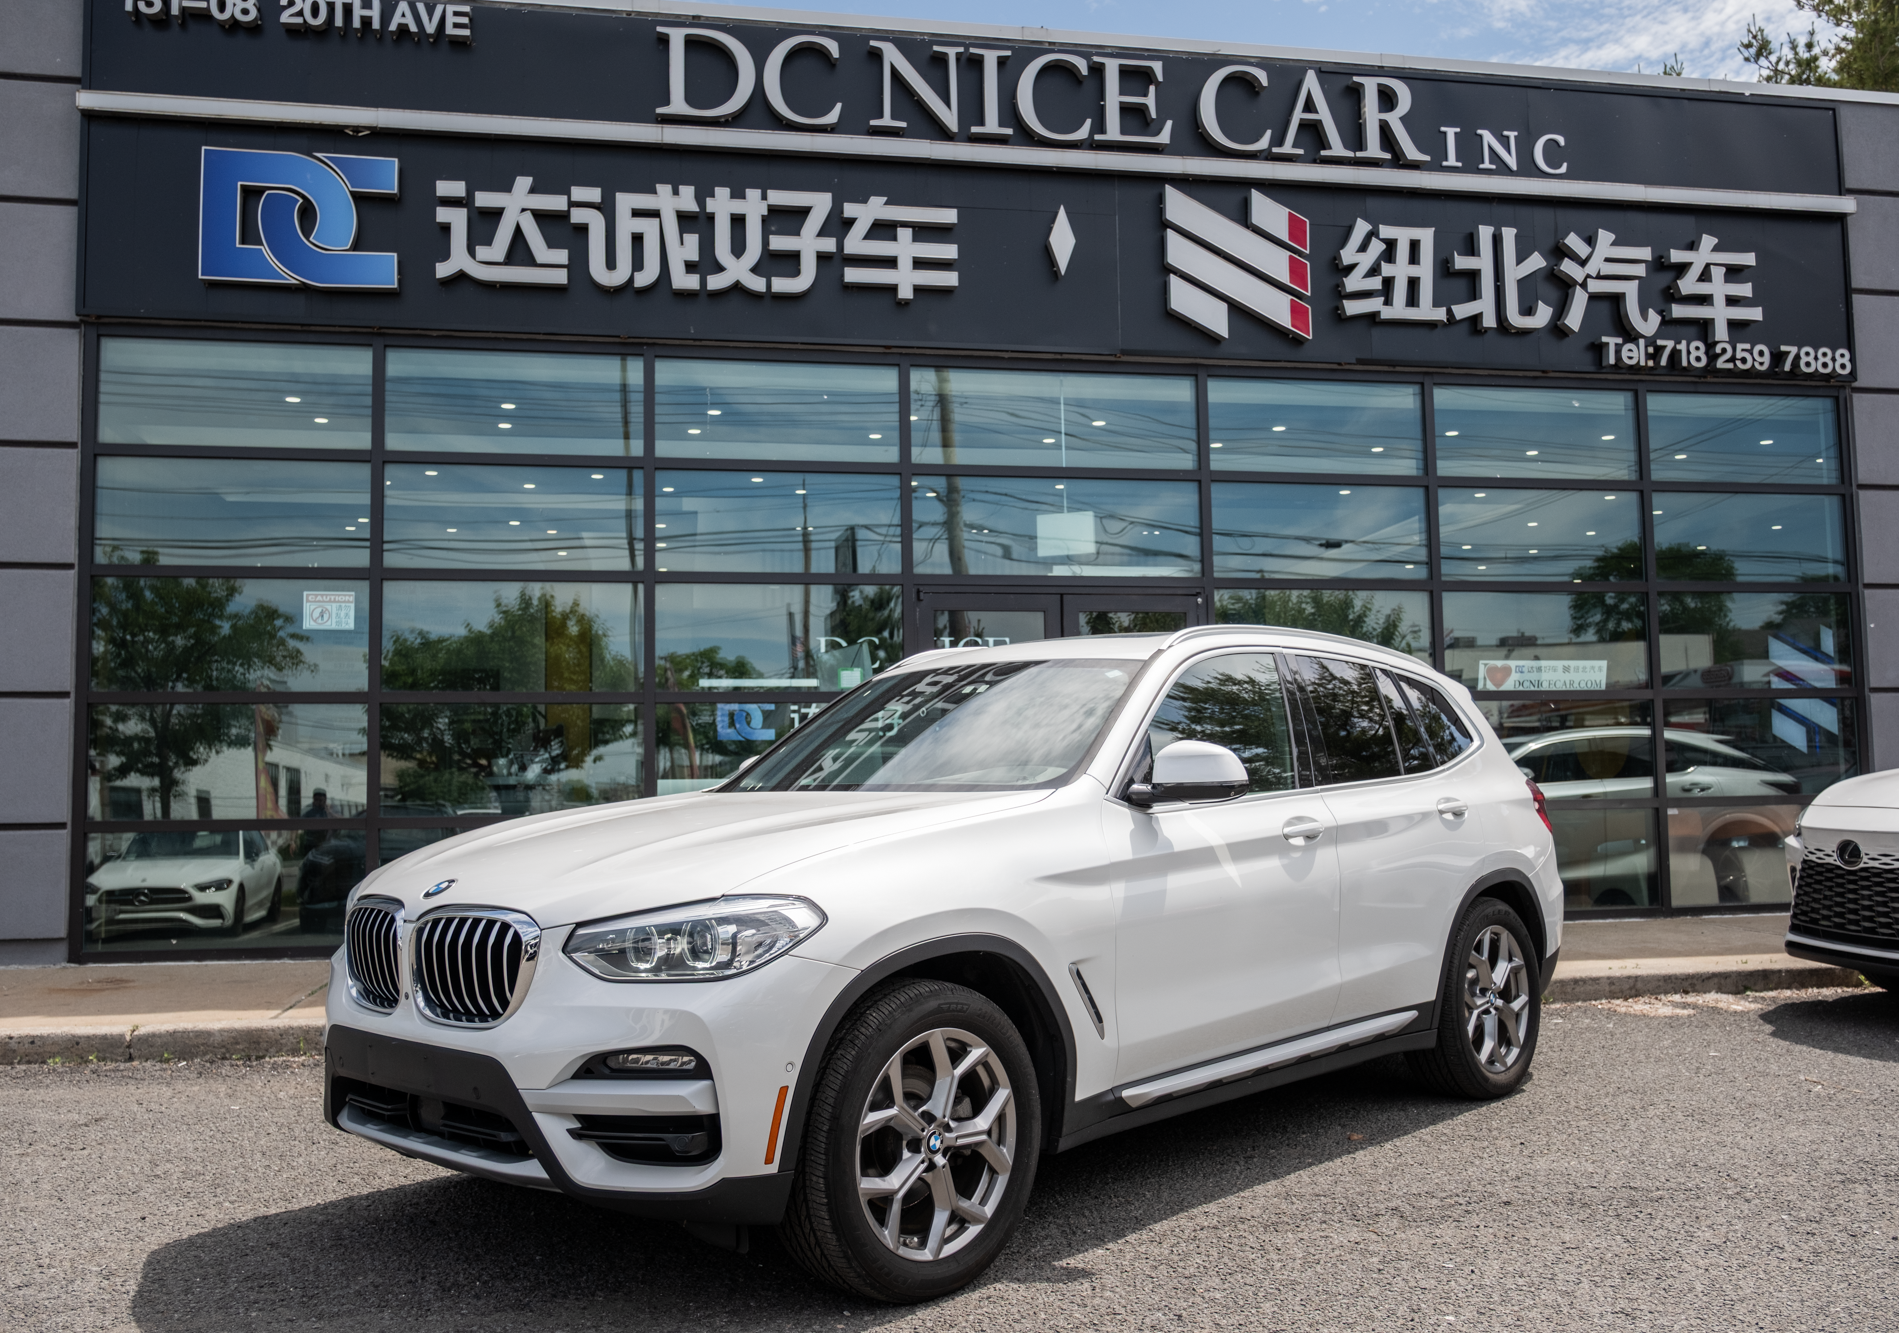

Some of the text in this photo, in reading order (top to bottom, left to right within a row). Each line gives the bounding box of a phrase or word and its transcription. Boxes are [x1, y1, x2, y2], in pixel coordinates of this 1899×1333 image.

[279, 0, 381, 31] 20TH
[388, 2, 472, 38] AVE
[655, 26, 1568, 174] DC NICE CAR INC
[436, 176, 959, 300] 达诚好车
[1339, 217, 1763, 342] 纽北汽车
[1715, 341, 1771, 371] 259
[1780, 345, 1852, 375] 7888
[1513, 680, 1602, 690] DCNICECAR.COM
